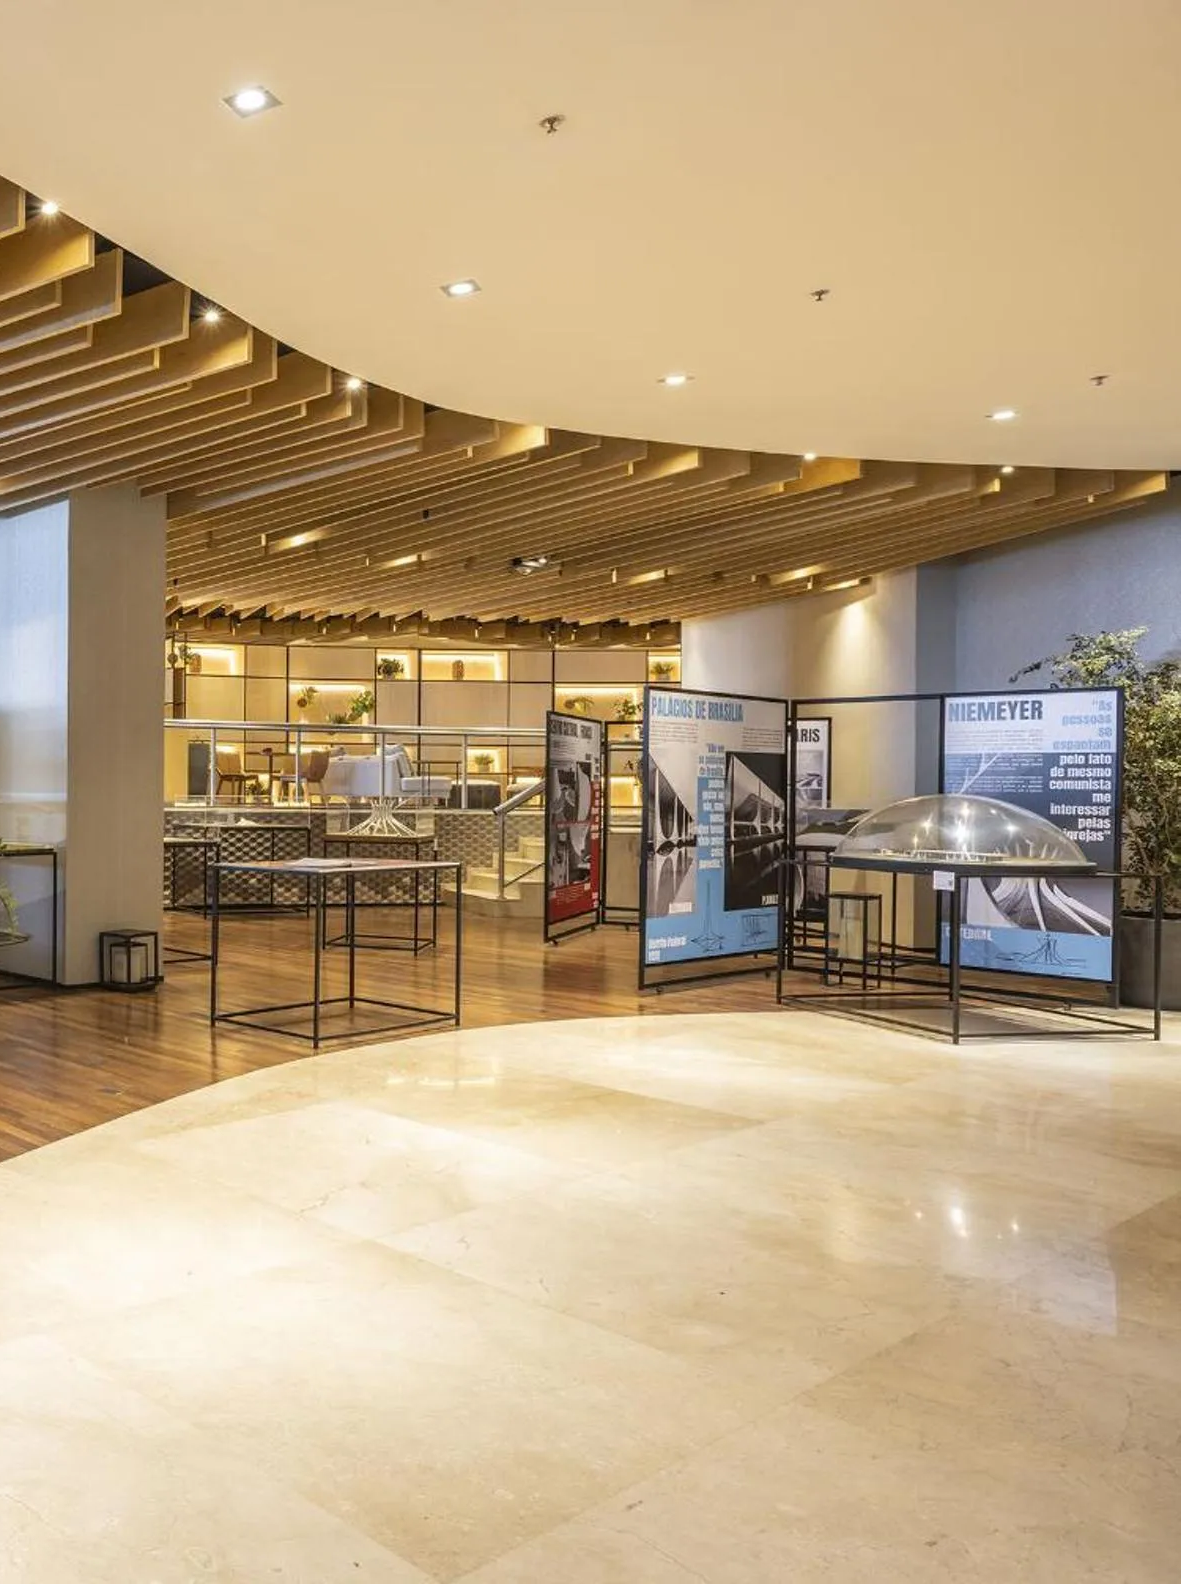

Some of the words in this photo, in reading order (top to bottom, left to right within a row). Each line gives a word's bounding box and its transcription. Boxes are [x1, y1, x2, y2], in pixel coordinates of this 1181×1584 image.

[948, 700, 1043, 722] NIEMEYER
[796, 728, 820, 743] RIS
[1059, 753, 1085, 766] pelo
[1088, 753, 1112, 765] fato
[1050, 766, 1064, 777] de
[1067, 767, 1112, 777] mesmo
[1049, 778, 1111, 790] comunista
[1092, 793, 1111, 803] me
[1050, 802, 1111, 816] interessar
[1078, 818, 1111, 829] pelas
